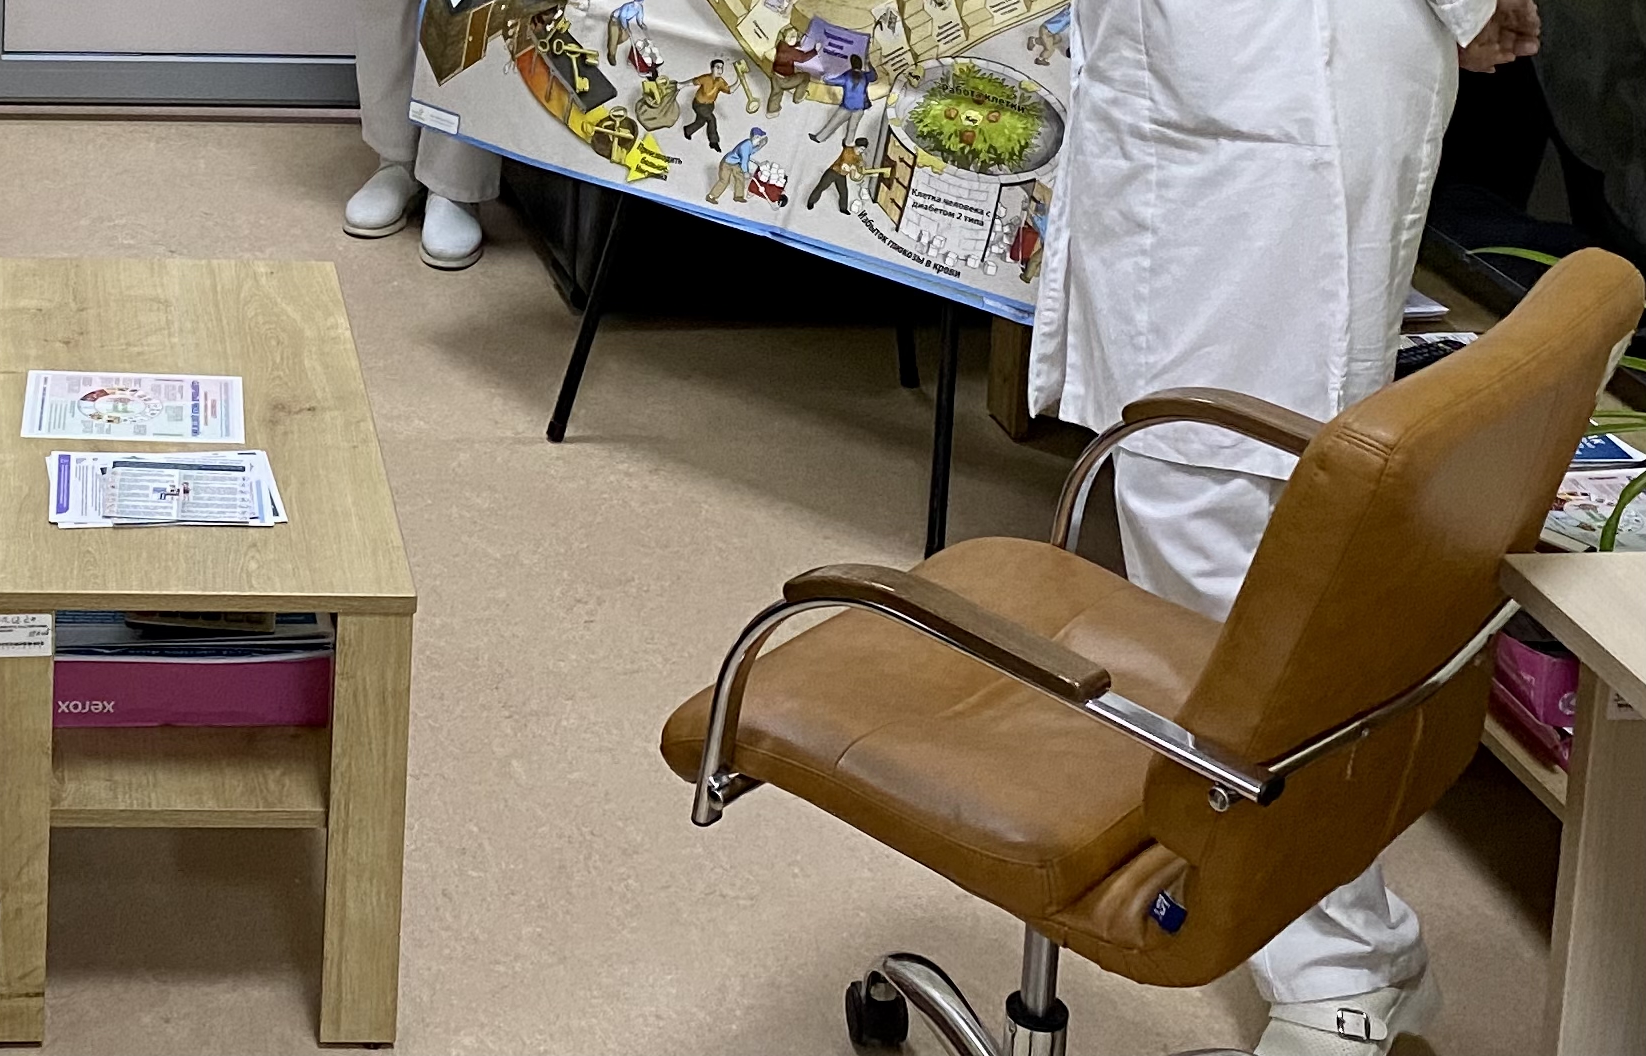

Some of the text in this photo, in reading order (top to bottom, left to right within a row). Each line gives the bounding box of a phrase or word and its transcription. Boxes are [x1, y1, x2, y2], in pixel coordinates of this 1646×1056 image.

[985, 94, 1026, 114] клетки
[911, 188, 942, 205] Клетка
[942, 197, 984, 217] человека
[911, 200, 985, 228] диабетом 2 типа
[857, 209, 962, 279] Избыток глюкозы в крови
[57, 700, 115, 713] xerox
